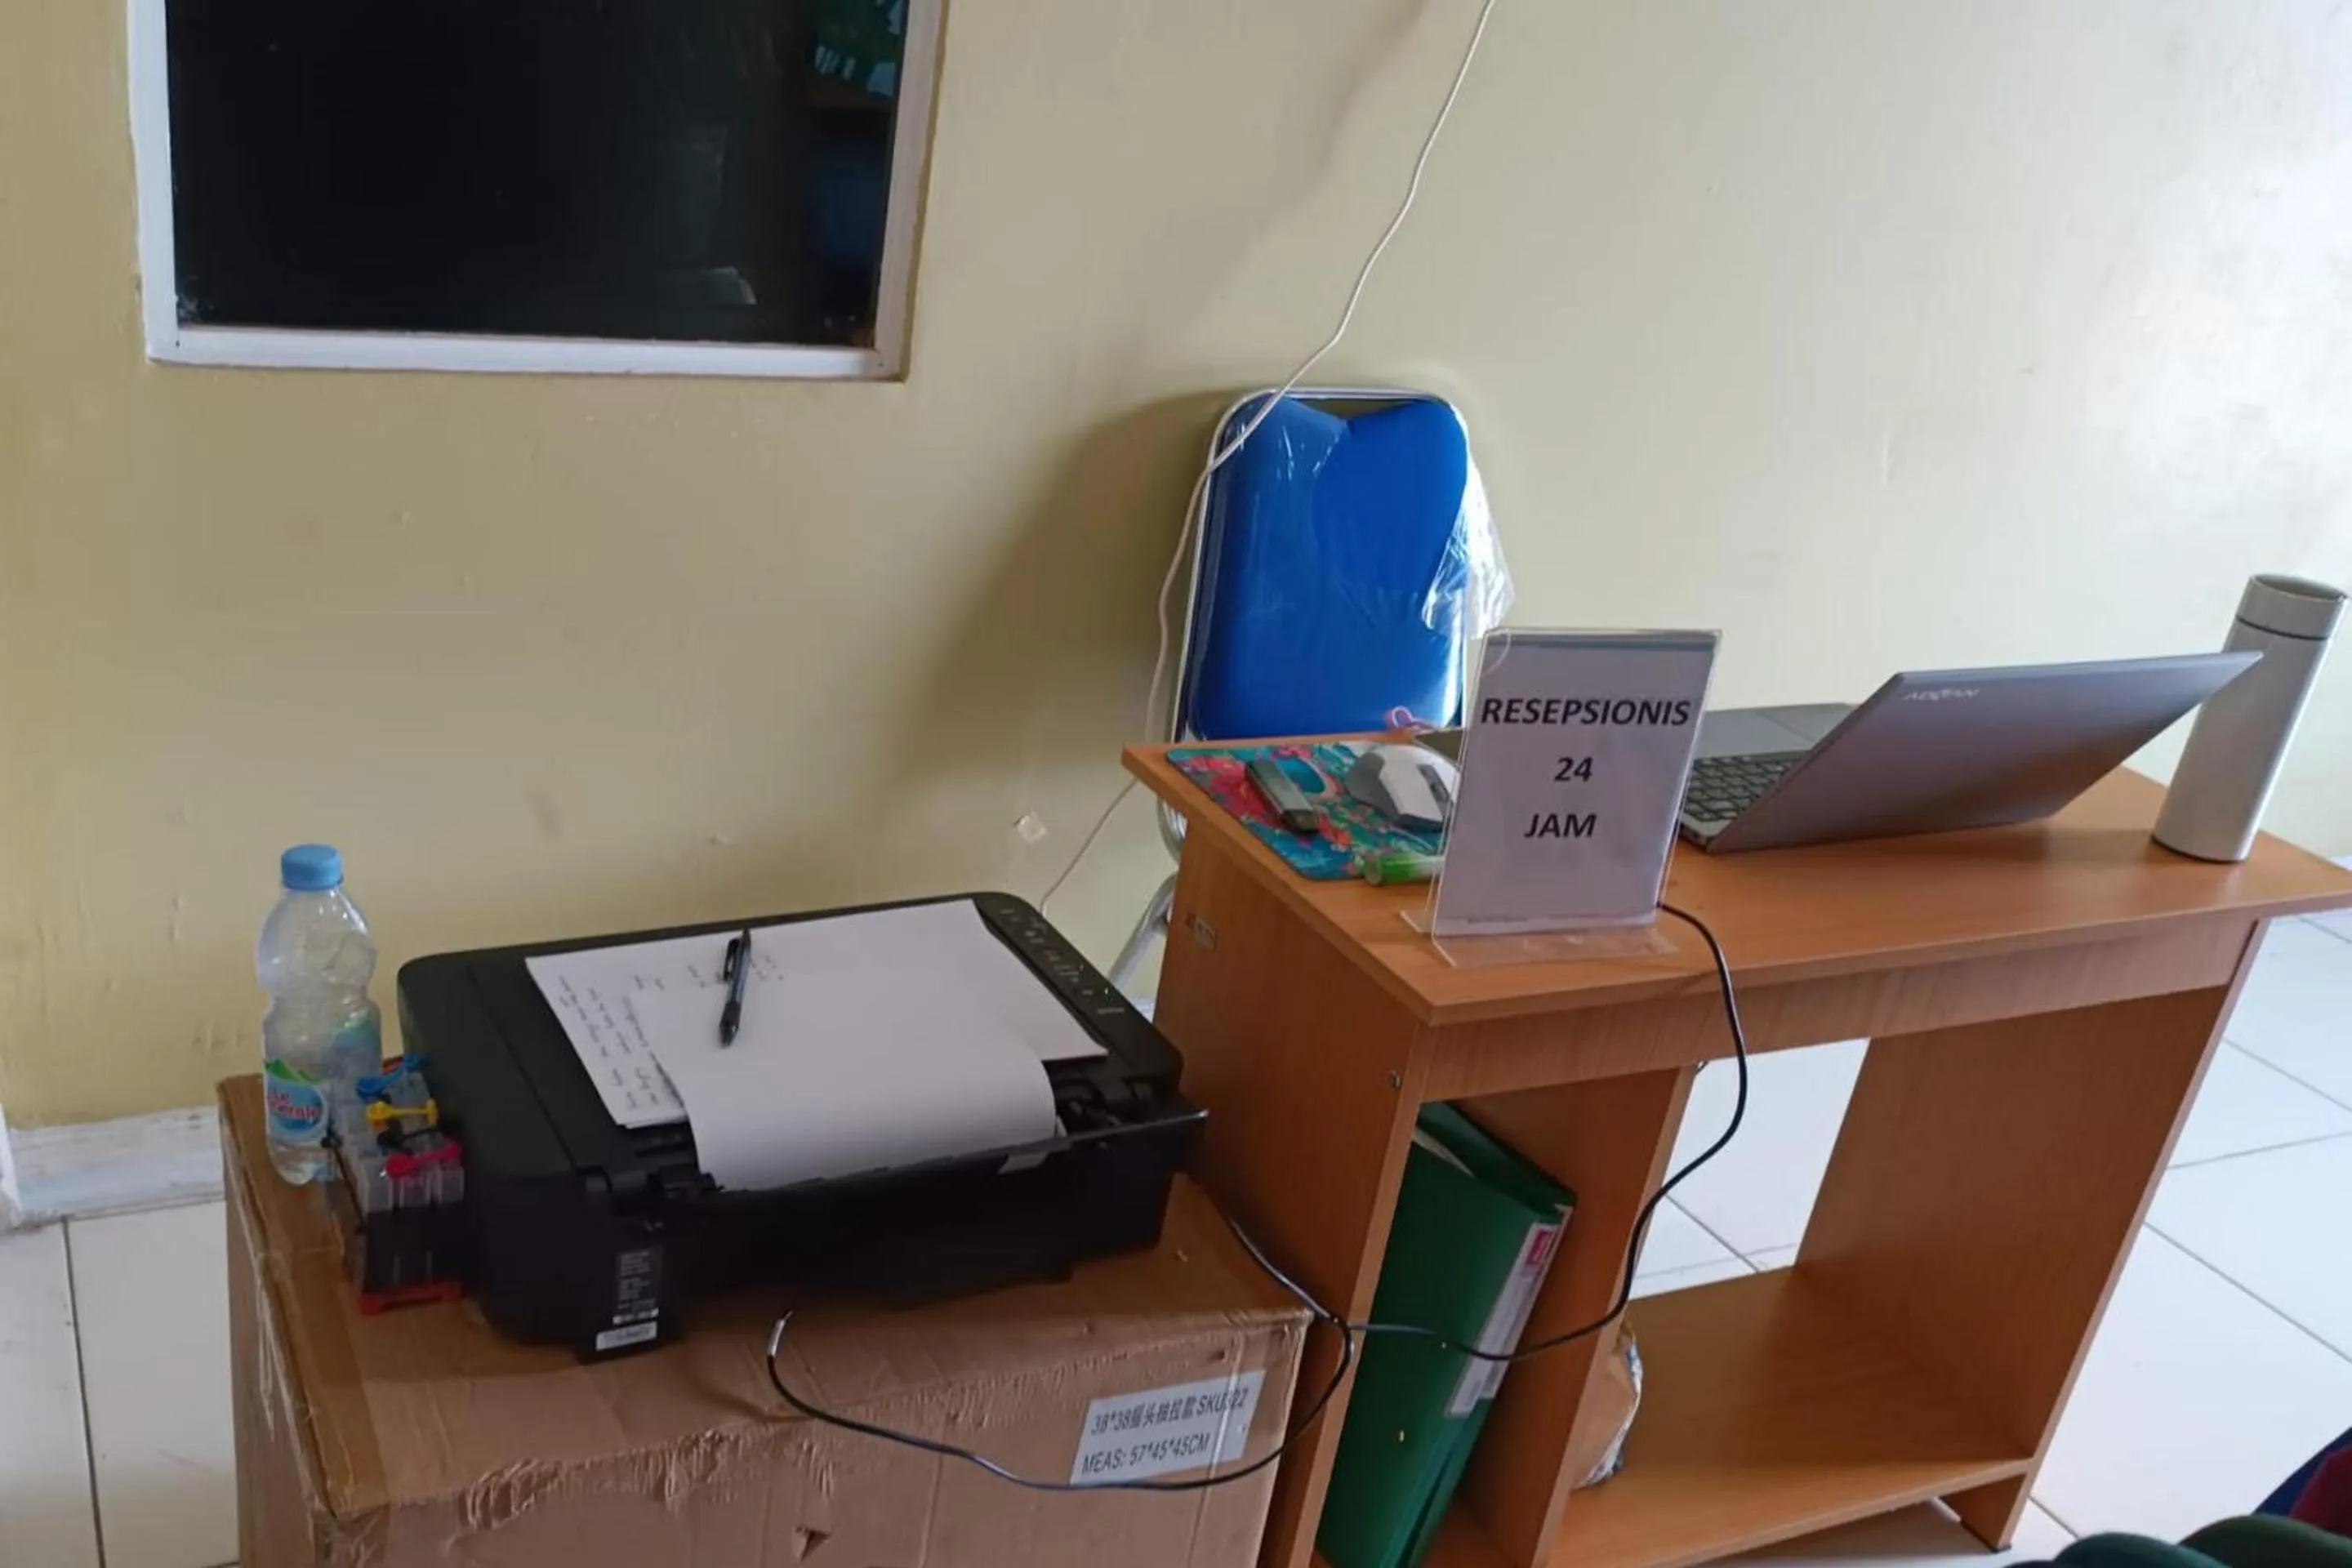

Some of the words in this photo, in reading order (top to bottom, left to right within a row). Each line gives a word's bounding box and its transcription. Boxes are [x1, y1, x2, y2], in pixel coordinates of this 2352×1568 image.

[1481, 697, 1690, 725] RESEPSIONIS
[1554, 757, 1592, 782] 24
[1524, 813, 1597, 838] JAM
[1081, 1450, 1125, 1475] MEAS:
